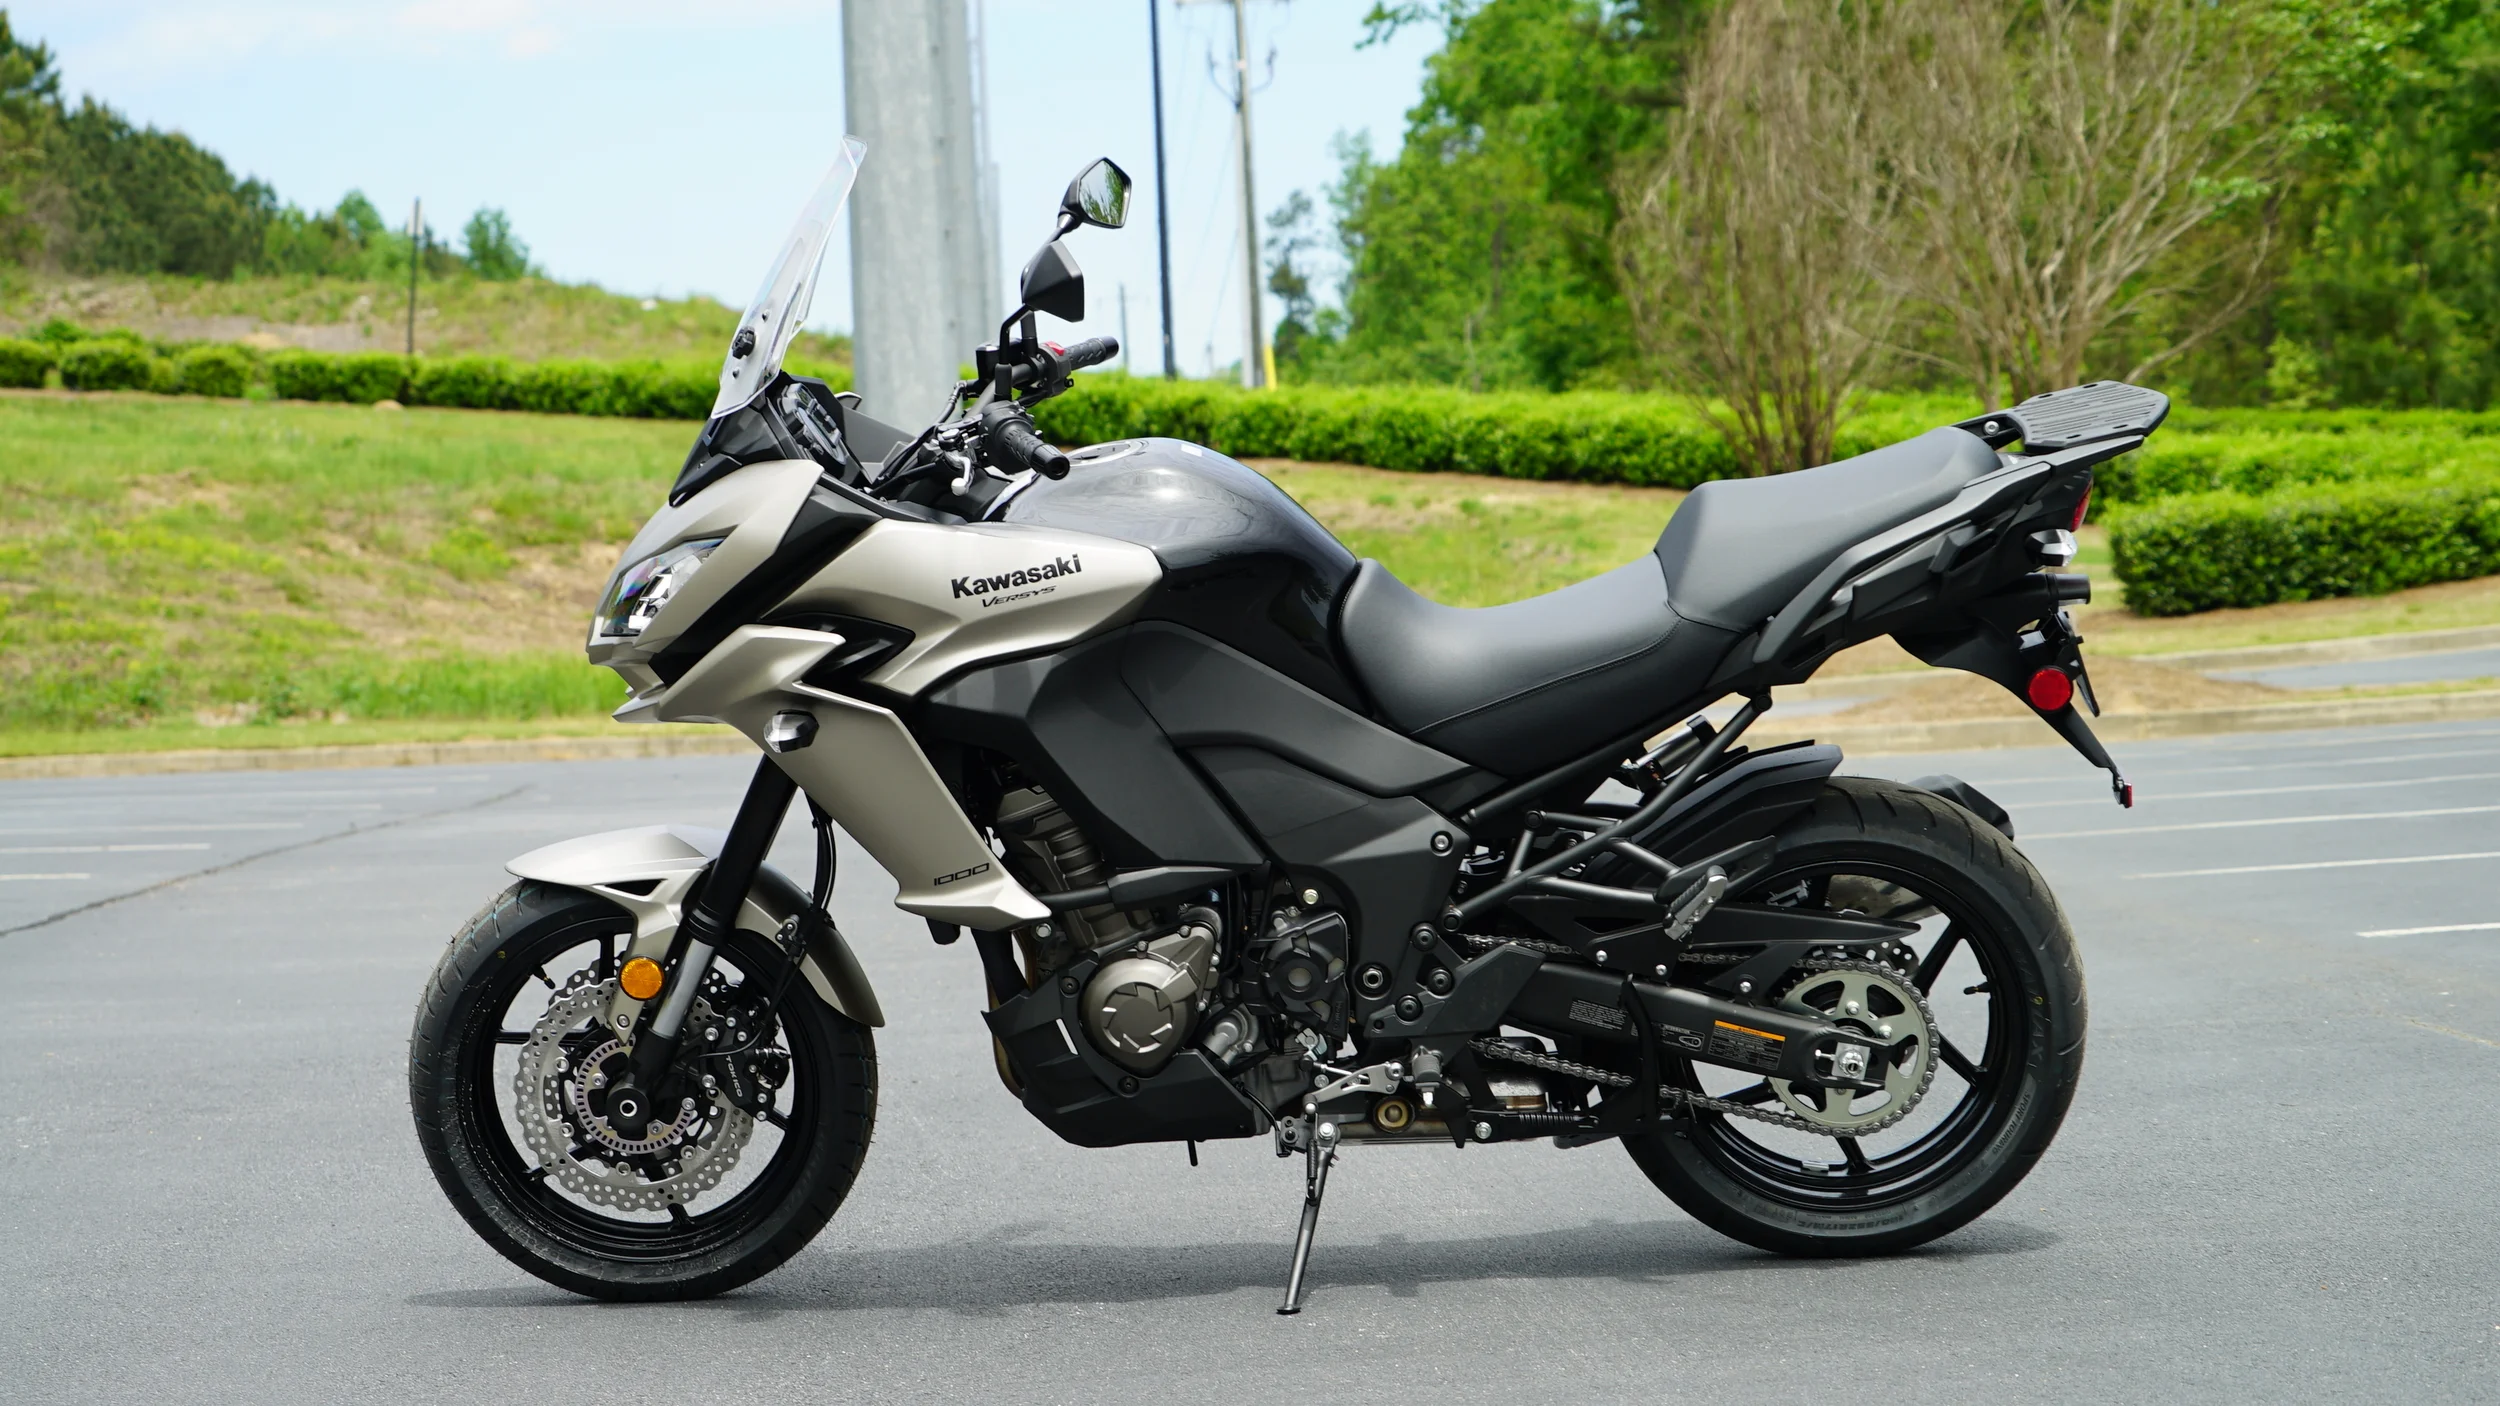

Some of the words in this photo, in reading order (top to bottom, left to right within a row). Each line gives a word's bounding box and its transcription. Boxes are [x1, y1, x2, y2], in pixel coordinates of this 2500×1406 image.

[951, 553, 1082, 599] Kawasaki
[981, 585, 1056, 608] VERSYS
[933, 862, 989, 886] 1000
[725, 1054, 743, 1098] TOKICO
